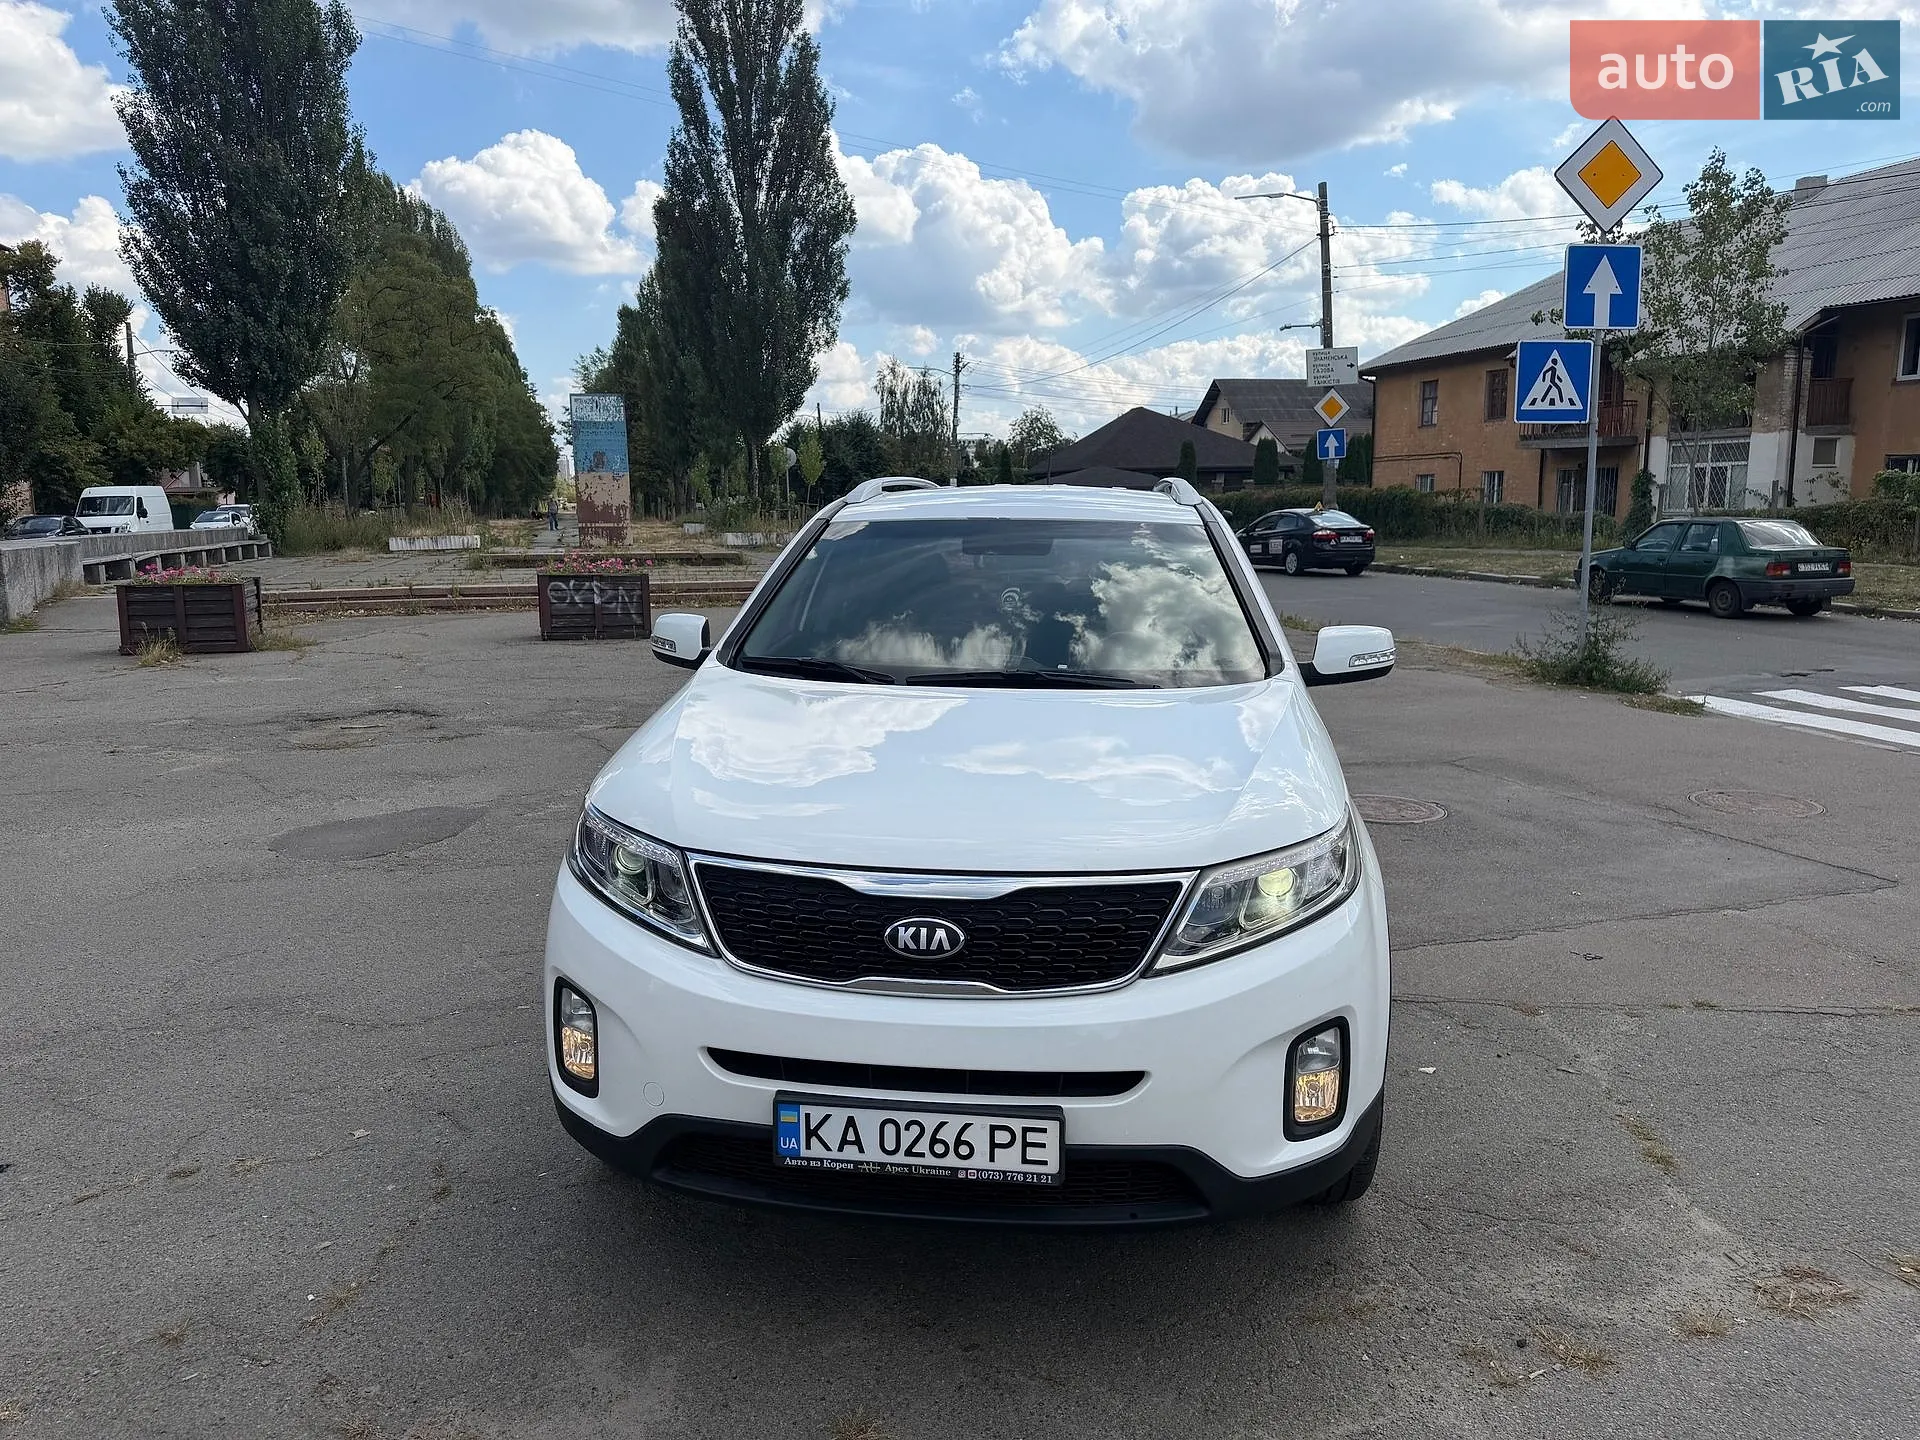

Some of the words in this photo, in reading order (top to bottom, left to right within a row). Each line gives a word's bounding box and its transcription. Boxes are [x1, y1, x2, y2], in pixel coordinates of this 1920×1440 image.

[896, 926, 951, 950] KIA
[780, 1136, 798, 1150] UA
[804, 1112, 866, 1154] KA
[878, 1117, 976, 1161] 0266
[988, 1123, 1049, 1166] PE
[784, 1156, 808, 1167] Авто
[884, 1164, 909, 1174] Apex
[912, 1165, 951, 1177] Ukraine
[978, 1171, 1004, 1181] (073)
[1006, 1173, 1024, 1182] 776
[1026, 1174, 1038, 1183] 21
[1040, 1175, 1053, 1184] 21
